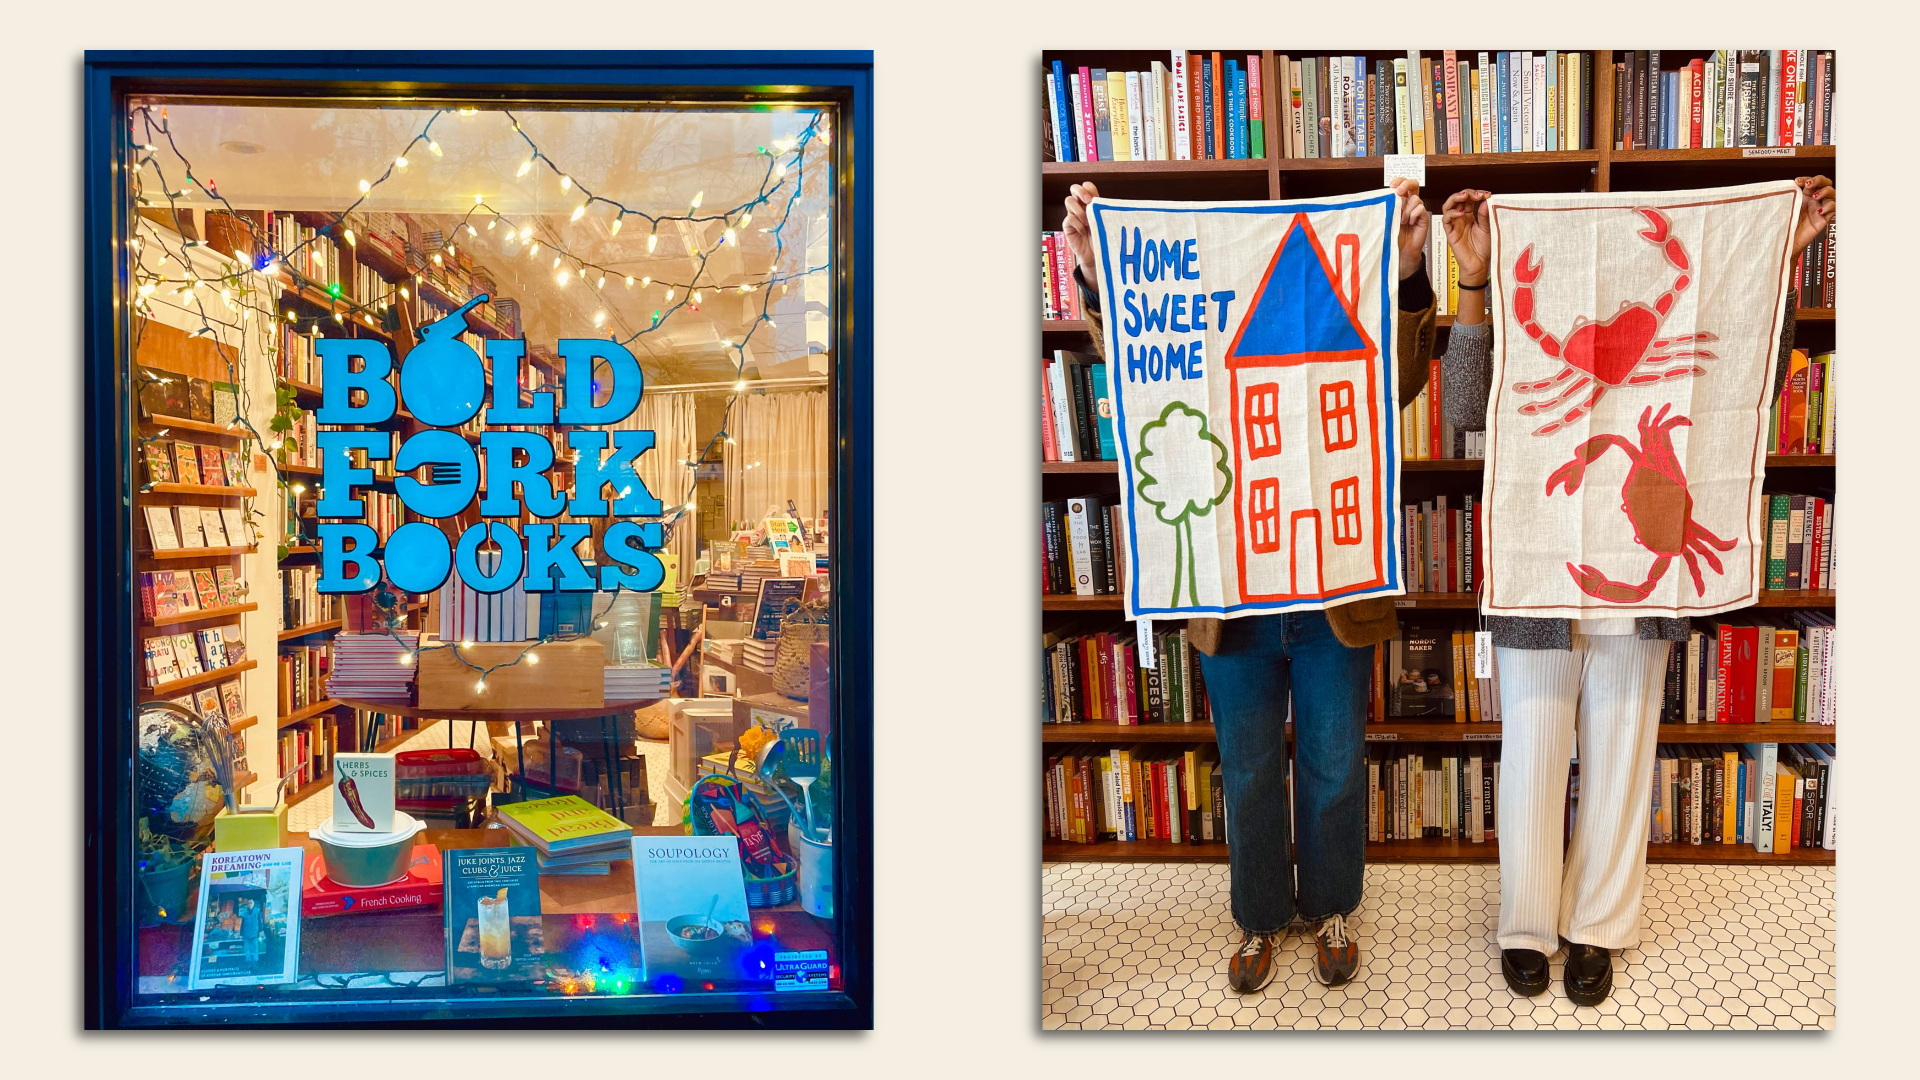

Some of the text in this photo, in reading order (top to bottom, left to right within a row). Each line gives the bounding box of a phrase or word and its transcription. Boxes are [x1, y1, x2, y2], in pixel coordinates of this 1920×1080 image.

[1175, 56, 1183, 79] HOME
[1786, 65, 1796, 88] ONE
[1094, 85, 1108, 113] grist
[1250, 58, 1260, 118] Cooking at Home
[1423, 84, 1432, 120] weekend
[1445, 58, 1457, 115] COMPANY
[1512, 70, 1520, 123] Now & Again
[1693, 72, 1701, 124] ACID TRIP
[1785, 91, 1795, 113] FISH
[1343, 76, 1351, 129] ROASTING
[1357, 102, 1365, 120] THE
[1370, 103, 1376, 113] As
[1548, 85, 1556, 128] FOODHEIM
[1178, 106, 1186, 132] BASICS
[1742, 107, 1750, 138] BOOK
[1195, 116, 1203, 160] PROVISIONS
[1119, 226, 1200, 286] HOME
[1827, 223, 1836, 279] MEATHEAD
[1057, 251, 1069, 299] salad freak
[1124, 289, 1235, 337] SWEET
[315, 317, 644, 427] BOLD
[1127, 340, 1203, 384] HOME
[316, 430, 663, 518] FORK
[1464, 513, 1472, 533] BLACK
[1805, 501, 1813, 537] PROVENCE
[317, 521, 665, 593] BOOKS
[1099, 651, 1108, 665] 365
[1723, 630, 1732, 666] ALPINE
[1717, 668, 1726, 712] COOKING
[342, 761, 370, 769] HERBS
[1483, 776, 1492, 814] ferment
[1715, 769, 1723, 799] FLORENTINE
[550, 807, 589, 821] and
[1685, 805, 1690, 813] My
[1762, 800, 1773, 831] ITALY!
[1806, 791, 1815, 819] SPQR
[546, 819, 616, 838] Bread
[211, 853, 271, 865] KOREATOWN
[211, 862, 262, 872] DREAMING
[458, 858, 477, 867] JUKE
[508, 856, 526, 864] JAZZ
[648, 848, 729, 859] SOUPOLOGY
[488, 864, 500, 878] &
[501, 866, 522, 874] JUICE
[360, 894, 422, 908] French Cooking
